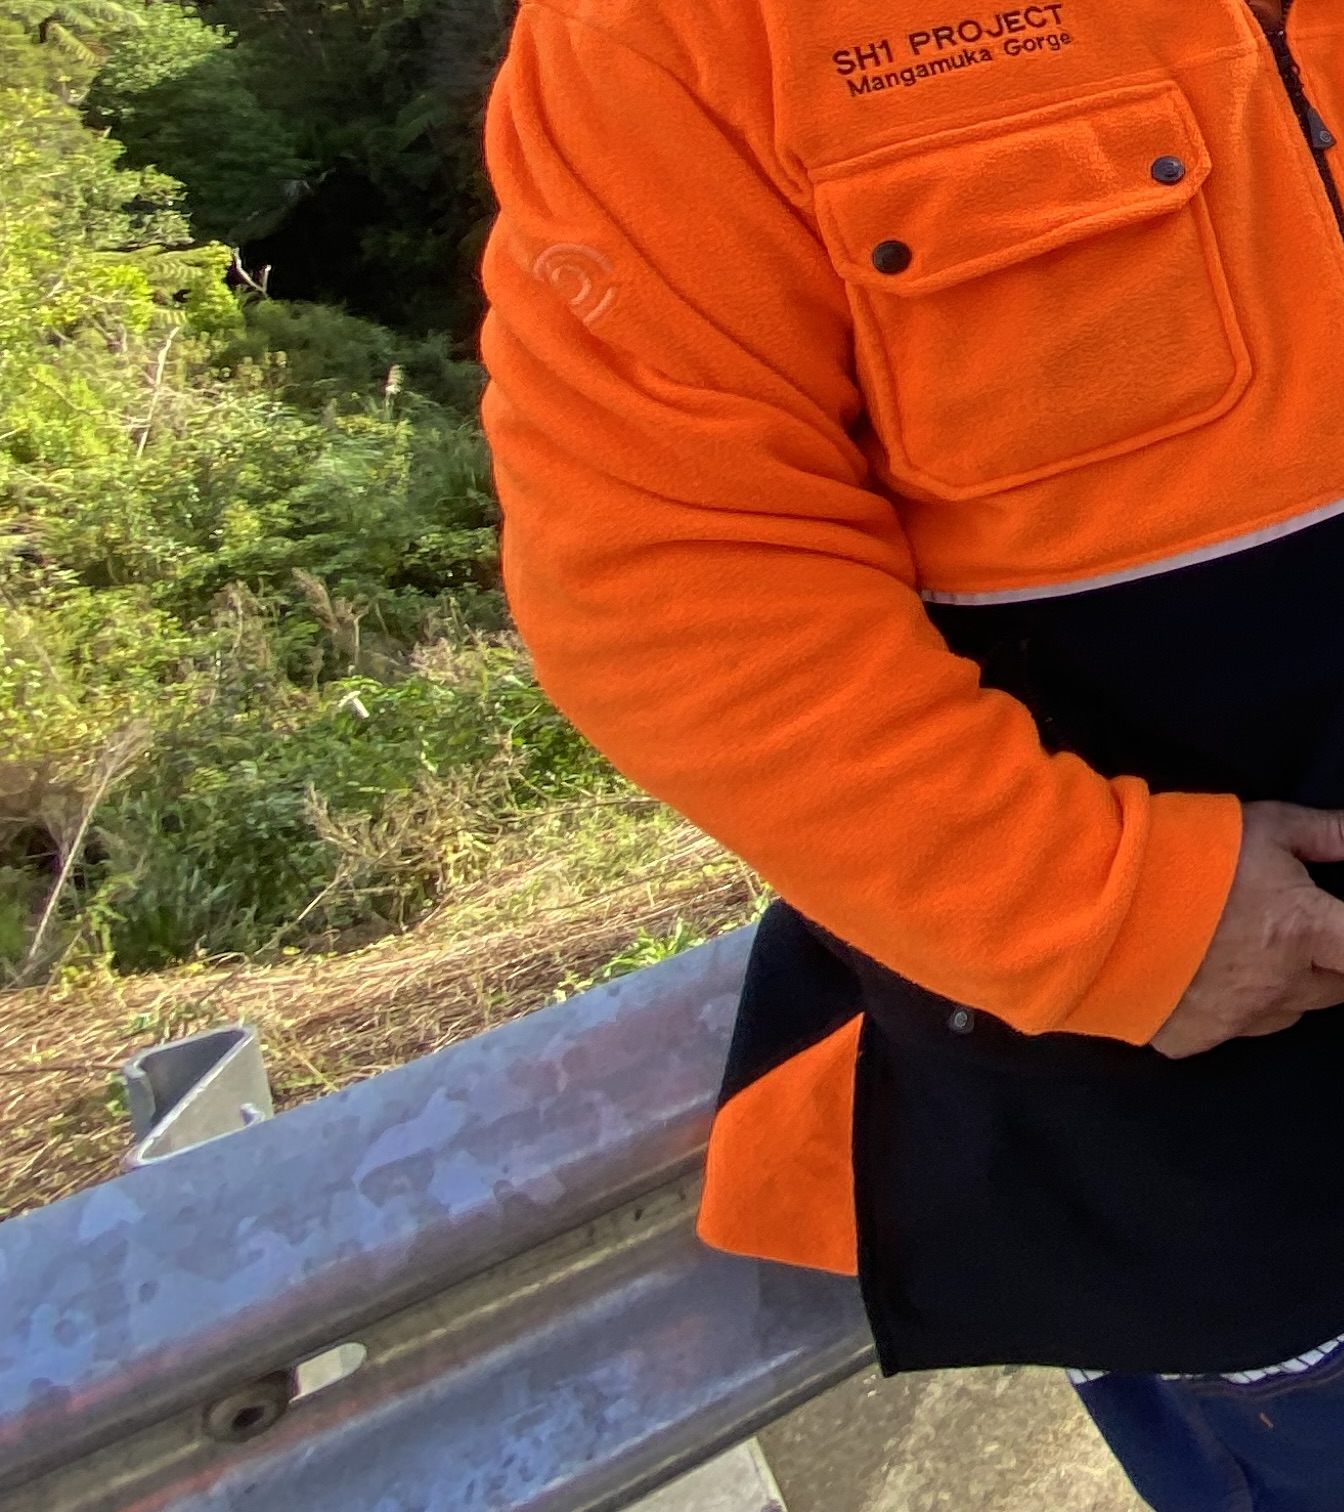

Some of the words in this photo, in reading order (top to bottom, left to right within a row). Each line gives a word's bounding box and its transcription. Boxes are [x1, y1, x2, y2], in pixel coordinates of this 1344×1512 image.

[832, 39, 894, 76] SH1
[908, 3, 1063, 56] PROJECT
[846, 48, 993, 97] Mangamuka
[1003, 30, 1073, 57] Gorge
